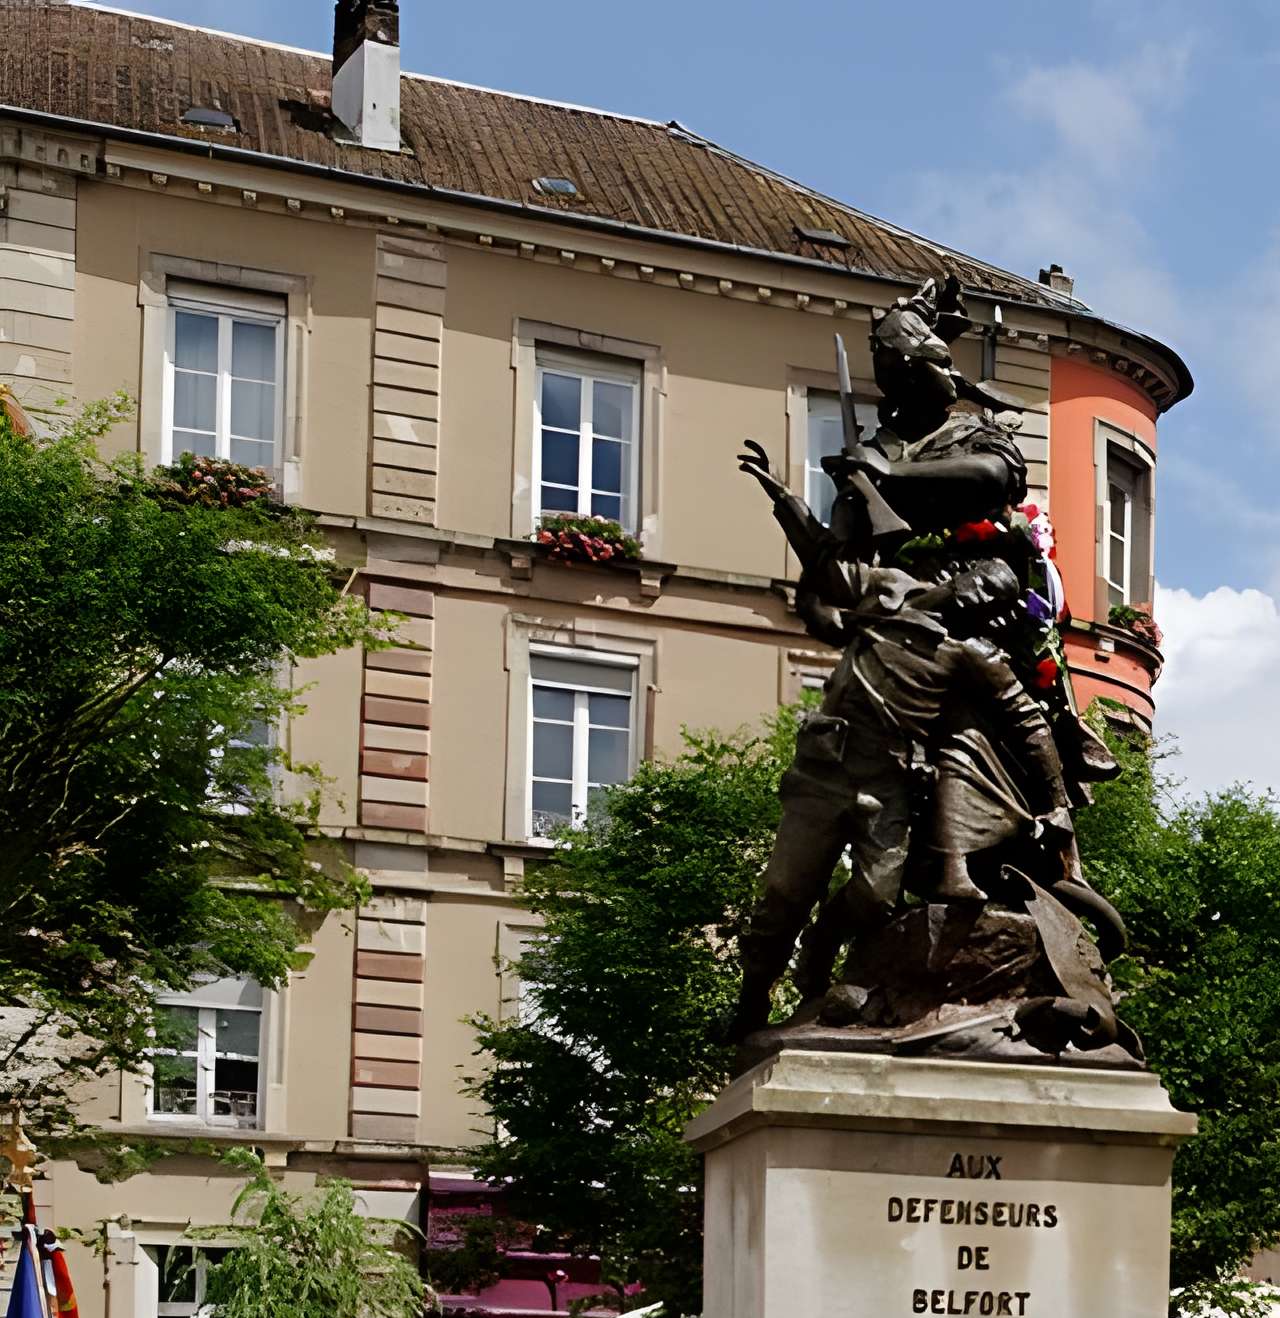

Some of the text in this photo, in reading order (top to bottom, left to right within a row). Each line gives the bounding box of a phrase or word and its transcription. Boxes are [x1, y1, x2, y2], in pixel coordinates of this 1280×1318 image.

[946, 1153, 1002, 1180] AUX
[887, 1197, 1058, 1228] DEFENSEURS
[957, 1246, 990, 1270] DE
[912, 1289, 1031, 1316] BELFORT
